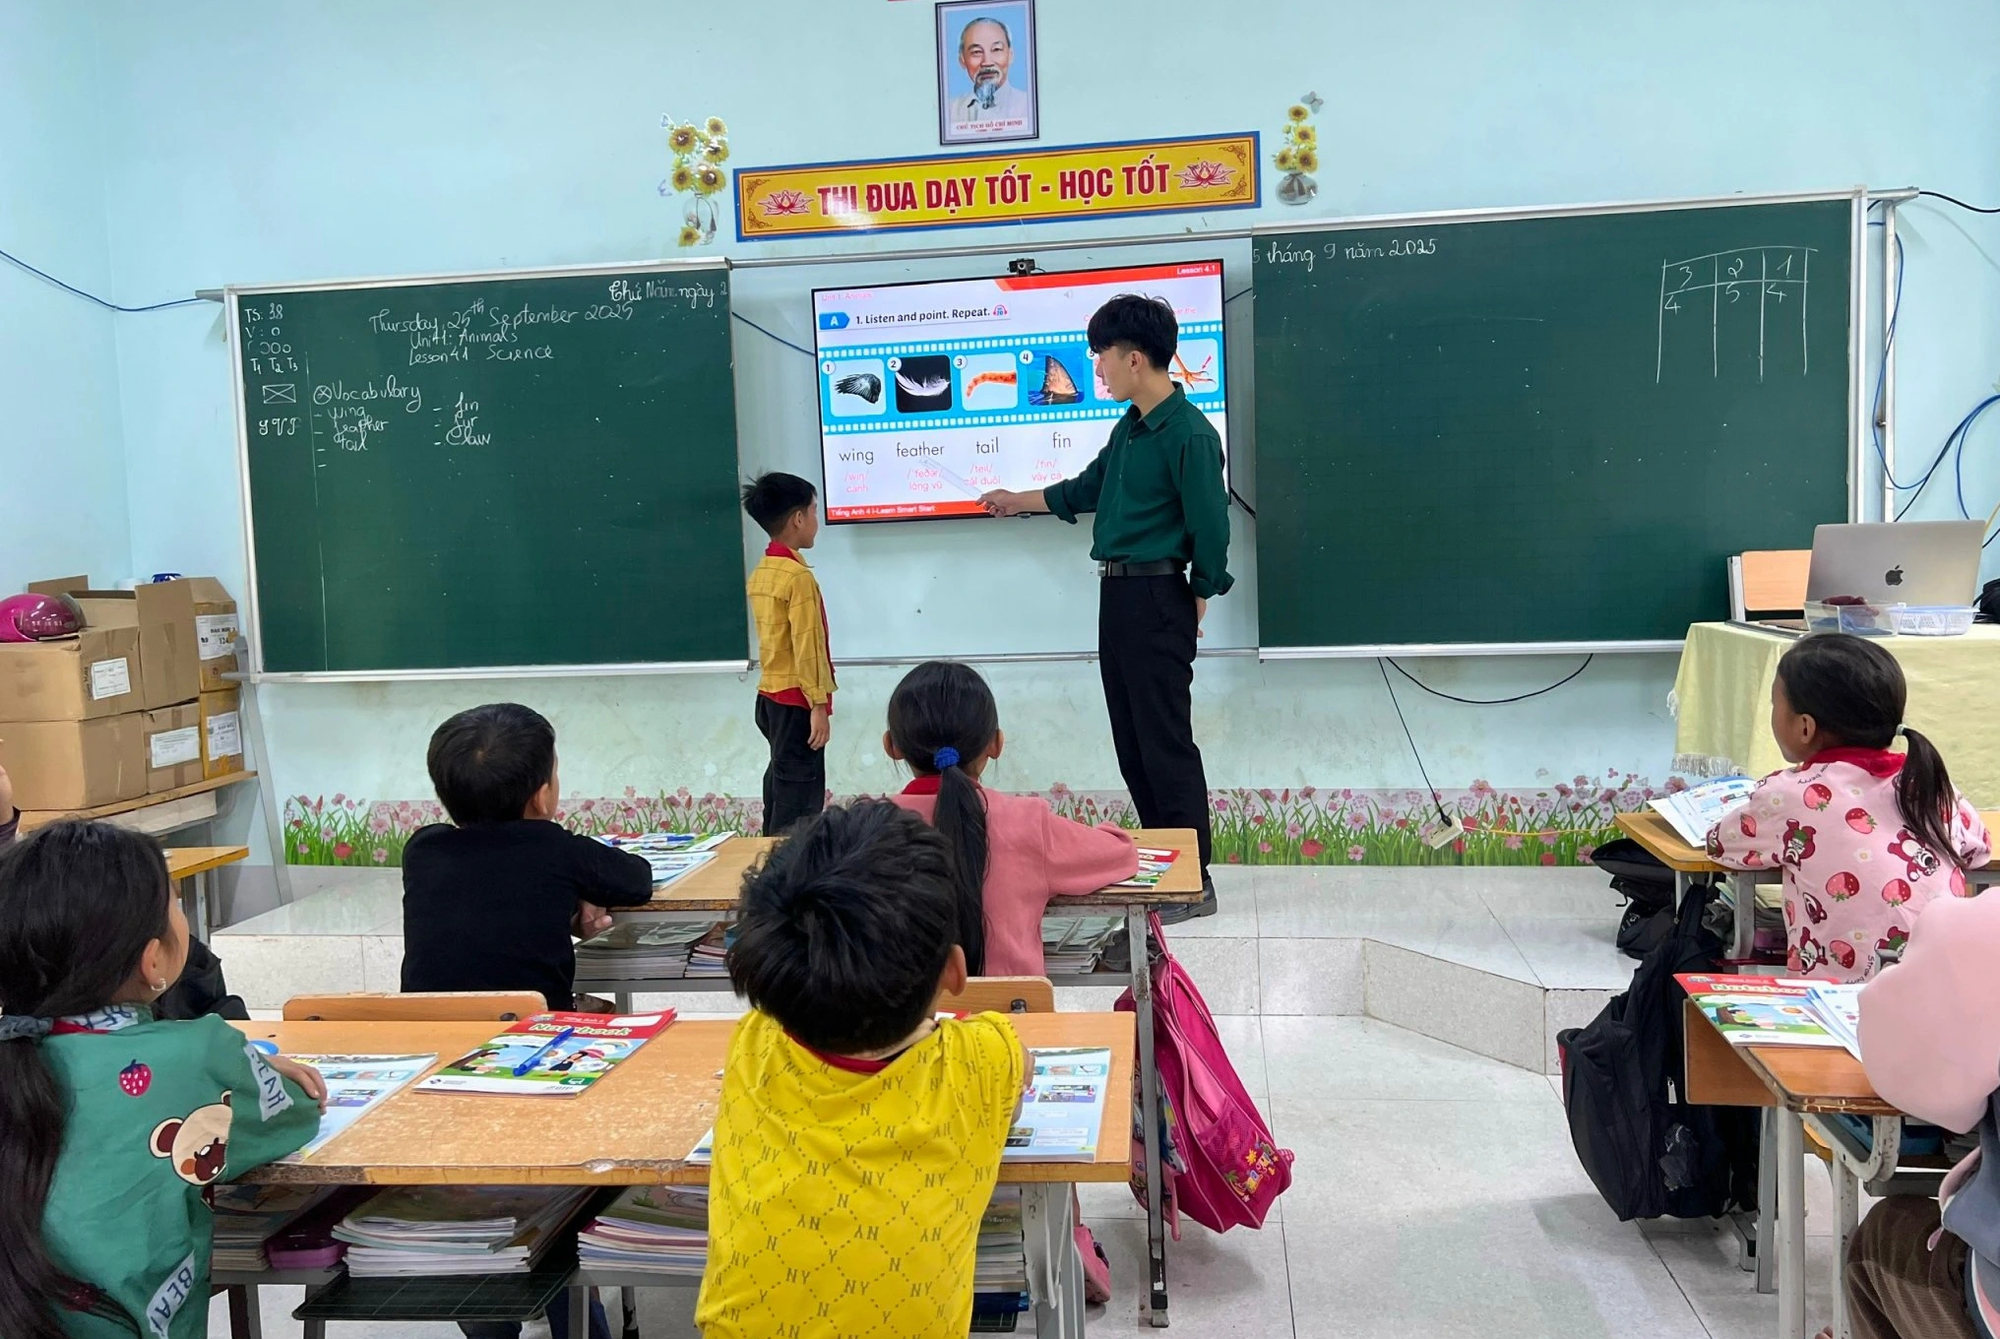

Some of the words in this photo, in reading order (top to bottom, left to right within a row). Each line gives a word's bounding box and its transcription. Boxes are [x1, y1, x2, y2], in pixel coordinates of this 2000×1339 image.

[817, 186, 858, 215] THI
[866, 182, 918, 212] ĐUA
[926, 177, 976, 213] DẠY
[985, 163, 1031, 206] TỐT
[1059, 168, 1113, 212] HỌC
[1122, 154, 1170, 195] TỐT
[1267, 242, 1316, 272] tháng
[1324, 243, 1336, 260] 9
[1344, 242, 1384, 260] năm
[1388, 238, 1438, 257] 2025
[1776, 254, 1792, 276] 1
[1176, 267, 1203, 275] Lesson
[678, 282, 715, 309] ngày
[1664, 295, 1682, 315] 4
[1766, 283, 1788, 304] 4
[489, 303, 579, 330] September
[584, 301, 634, 321] 2025
[830, 316, 838, 326] A
[856, 316, 862, 324] 1.
[865, 314, 895, 324] Listen
[897, 312, 917, 322] and
[919, 310, 950, 322] point.
[952, 306, 990, 320] Repeat.
[459, 324, 518, 346] Animals
[410, 348, 448, 366] Lesson
[486, 344, 554, 362] Science
[1022, 352, 1030, 363] 4
[332, 374, 422, 413] Vocabulary
[896, 441, 945, 457] feather
[976, 436, 999, 454] tail
[1052, 432, 1072, 448] fin
[839, 448, 874, 465] wing
[529, 1024, 632, 1036] Notbook
